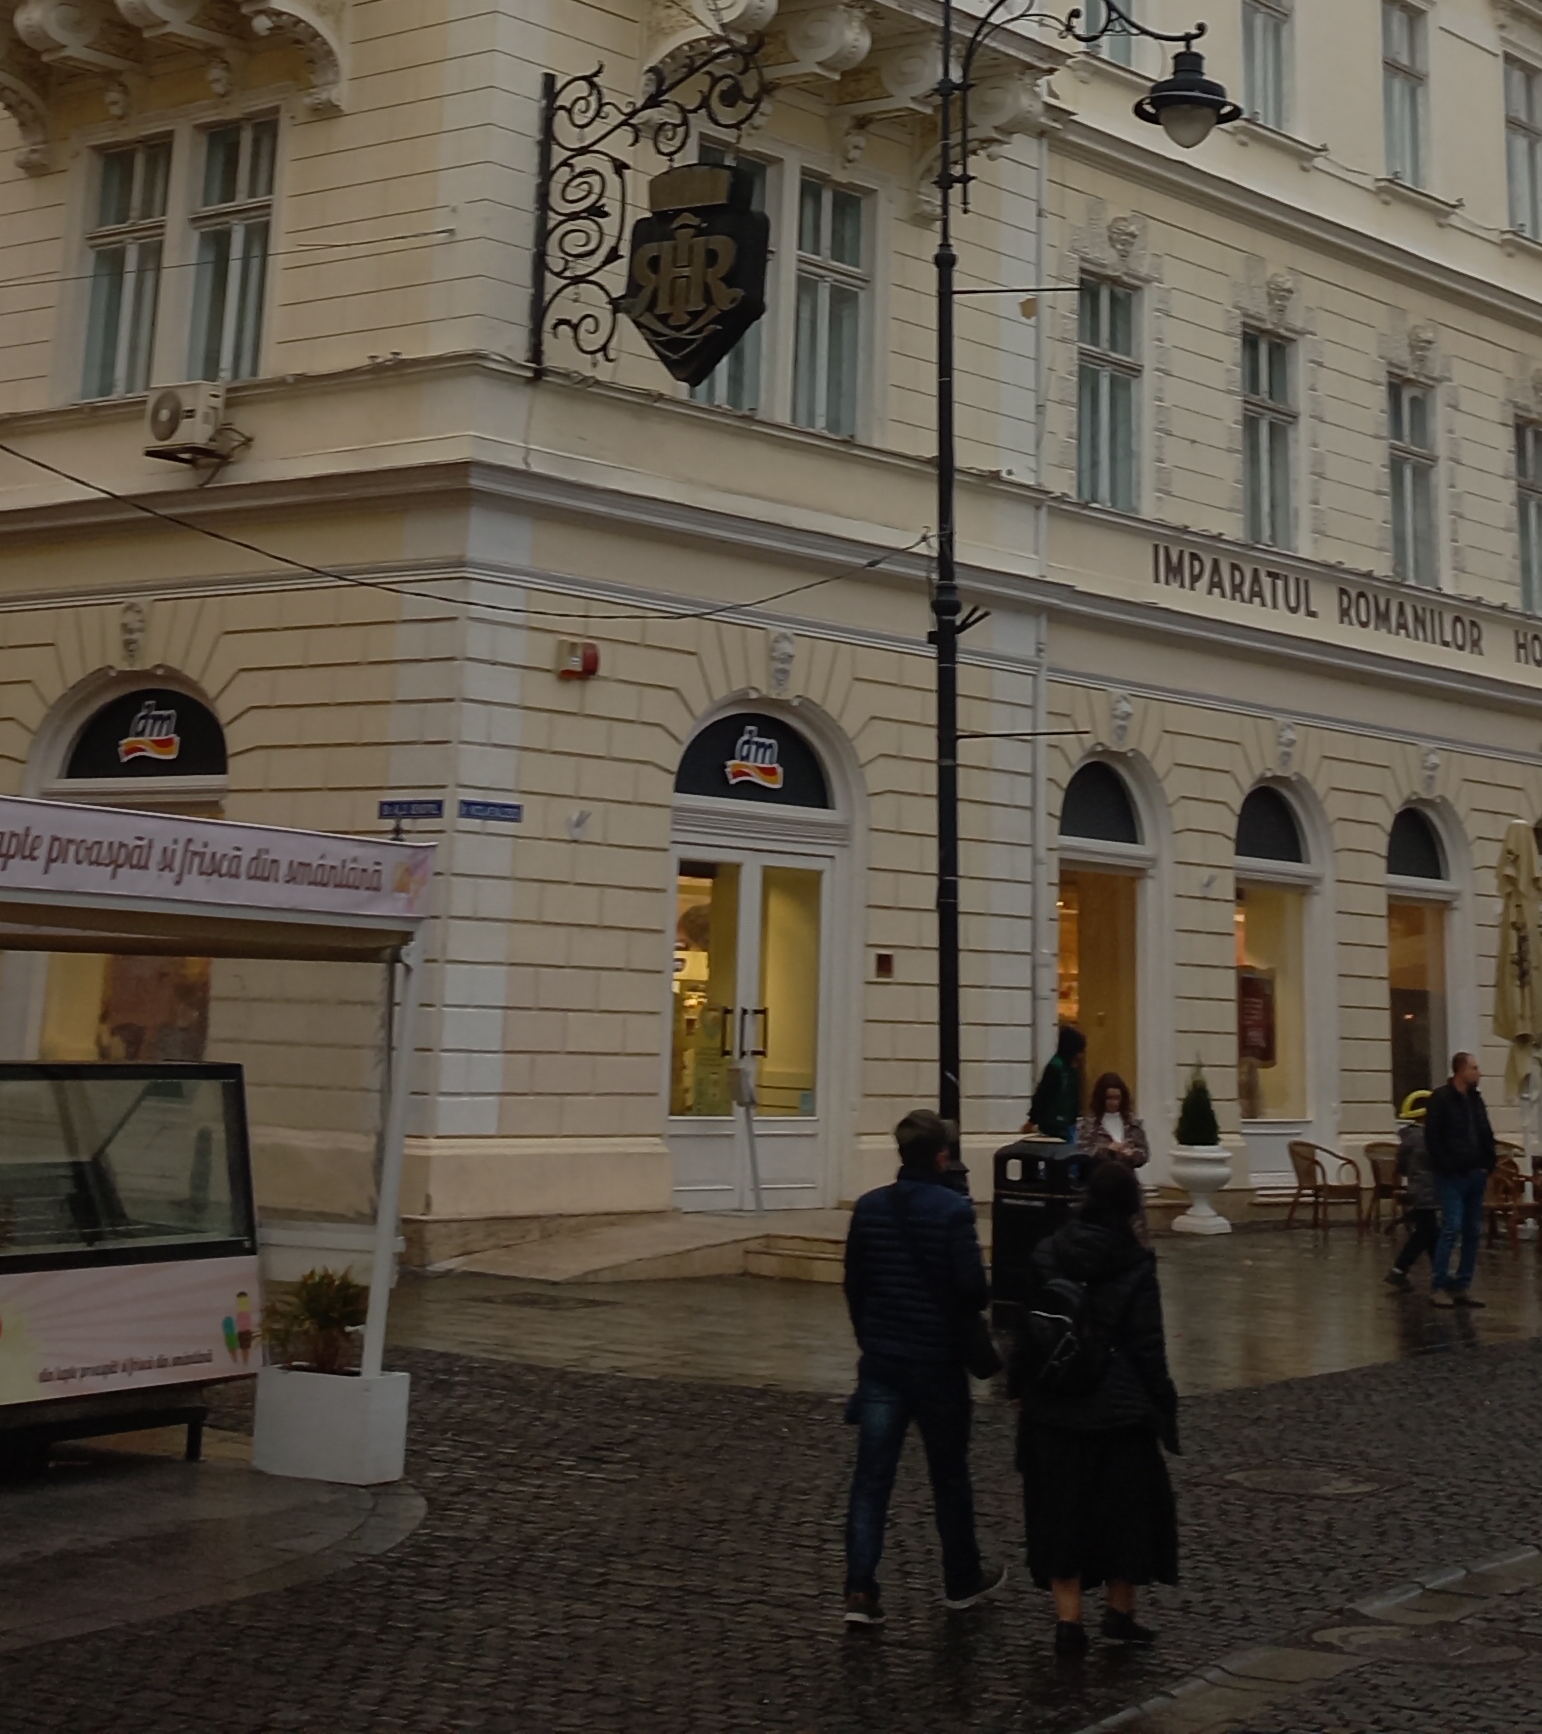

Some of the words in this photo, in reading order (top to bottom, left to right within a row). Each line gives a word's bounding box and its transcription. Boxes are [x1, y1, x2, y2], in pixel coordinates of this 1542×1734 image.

[1152, 542, 1319, 619] IMPARATUL
[1337, 585, 1485, 657] ROMANILOR
[126, 700, 178, 737] dm
[734, 725, 779, 764] dm
[42, 835, 154, 876] proaspăt
[245, 847, 281, 883] din
